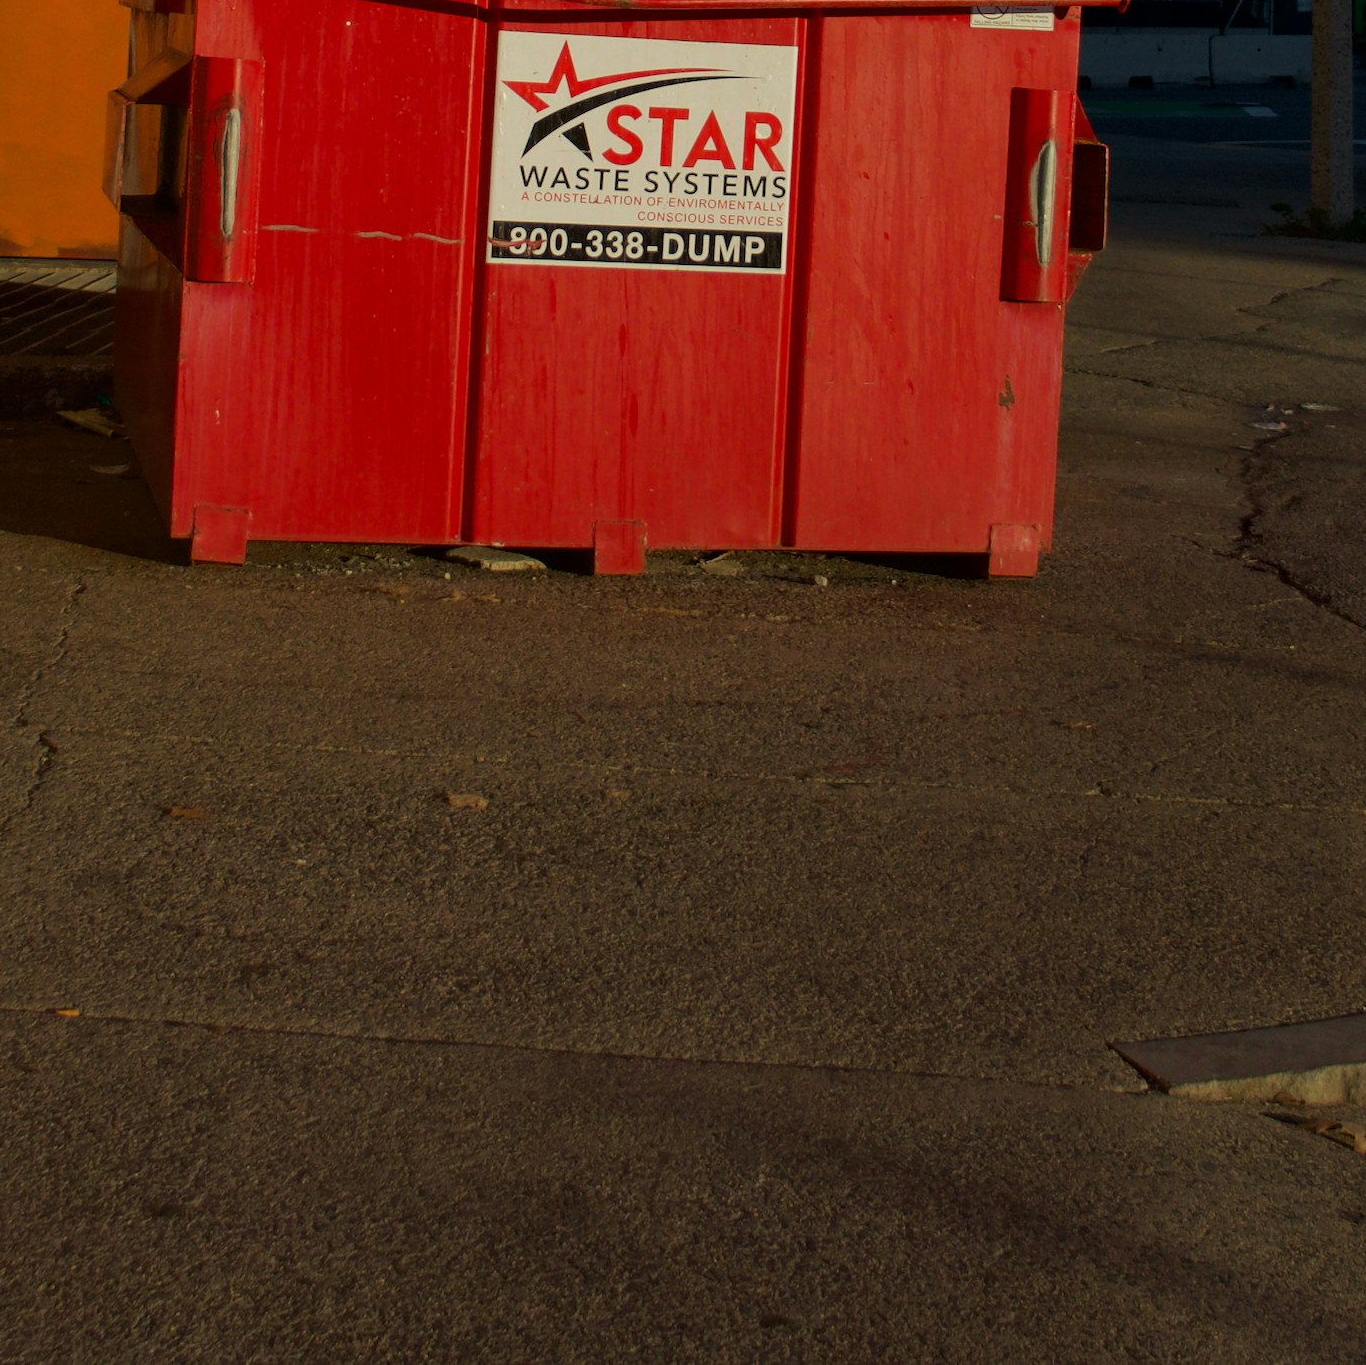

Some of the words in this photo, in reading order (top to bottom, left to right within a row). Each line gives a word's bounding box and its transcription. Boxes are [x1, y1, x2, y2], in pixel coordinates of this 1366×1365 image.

[602, 104, 785, 172] STAR
[519, 165, 630, 192] WASTE
[644, 170, 787, 199] SYSTEMS
[521, 191, 530, 202] A
[534, 191, 642, 206] CONSTELLATION
[647, 196, 664, 207] OF
[668, 197, 784, 212] ENVIROMENTALLY
[637, 211, 716, 224] CONSCIOUS
[719, 214, 784, 227] SERVICES
[508, 226, 766, 263] 800-338-DUMP
